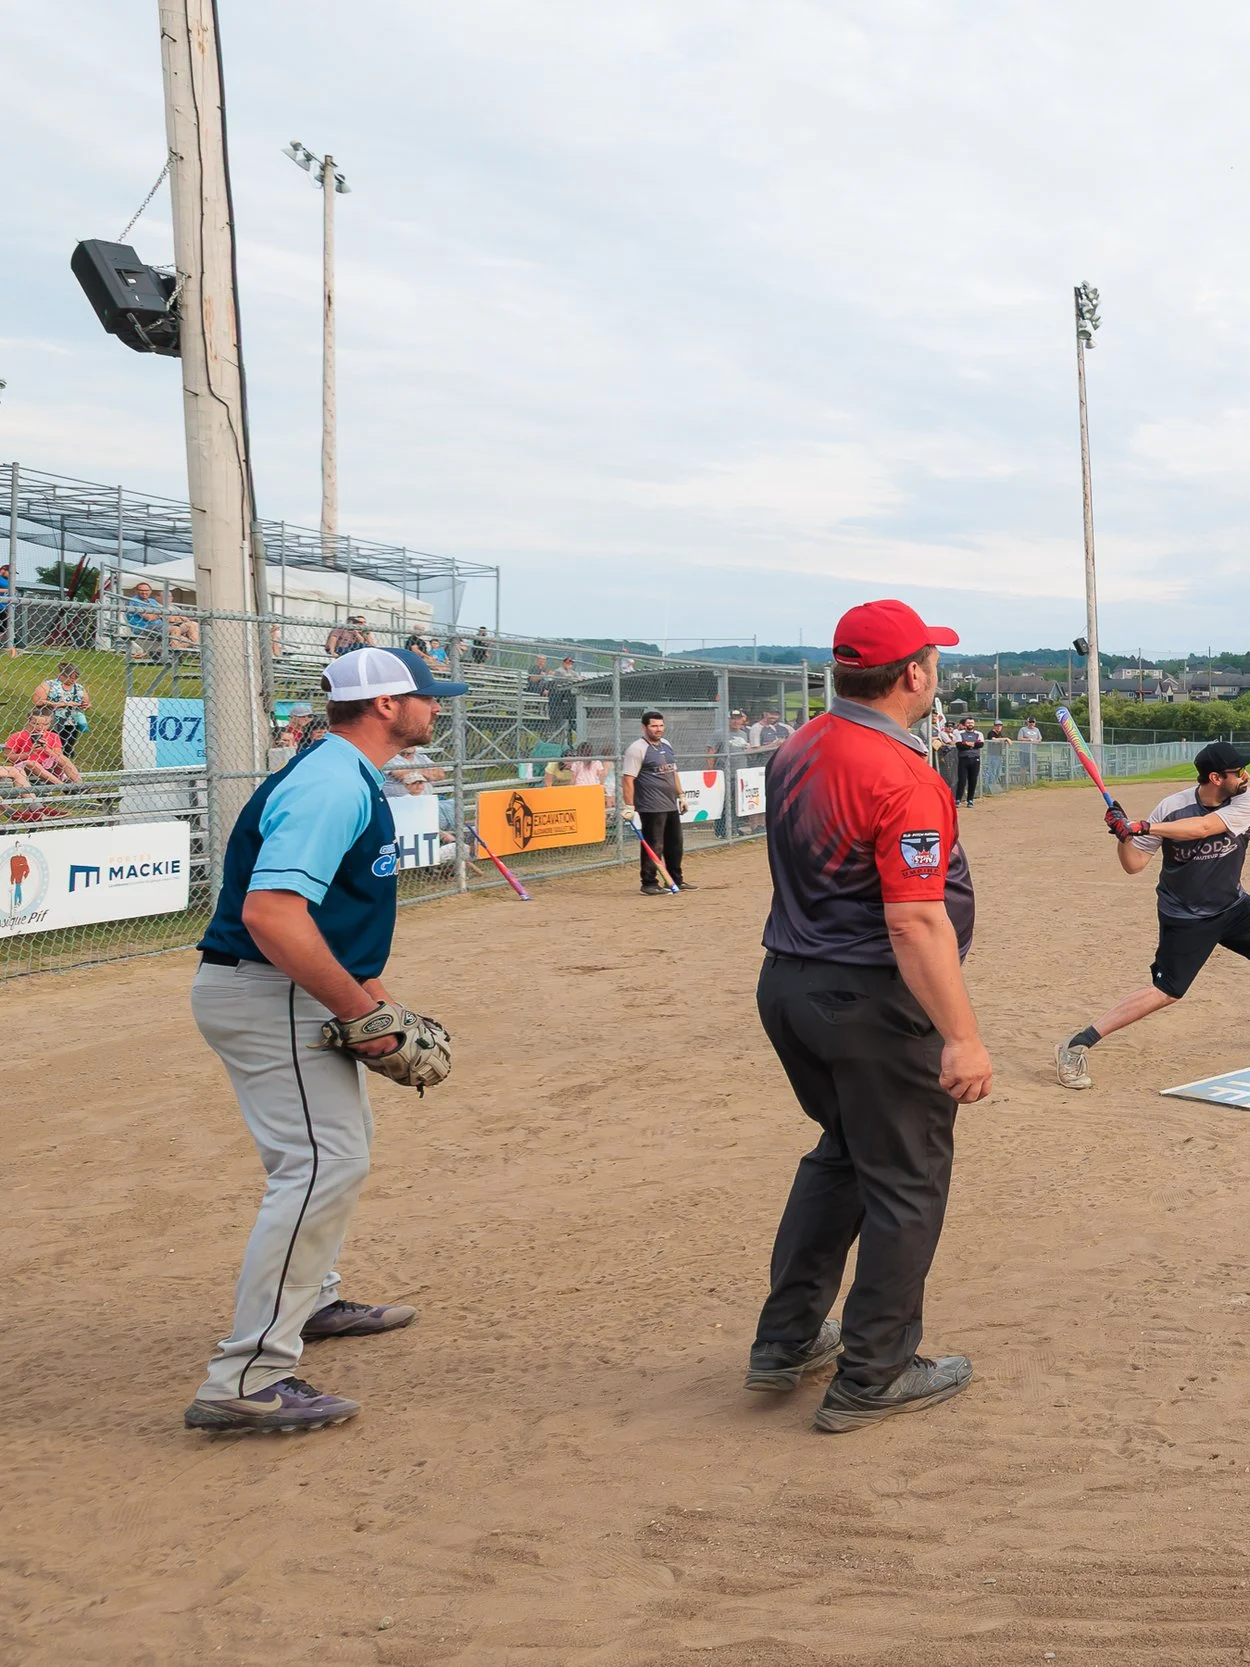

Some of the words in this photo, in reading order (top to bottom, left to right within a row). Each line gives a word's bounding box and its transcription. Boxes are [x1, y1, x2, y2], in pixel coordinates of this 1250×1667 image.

[533, 812, 576, 827] EXCAVATION
[109, 860, 181, 881] MACKIE
[27, 909, 50, 924] Pif
